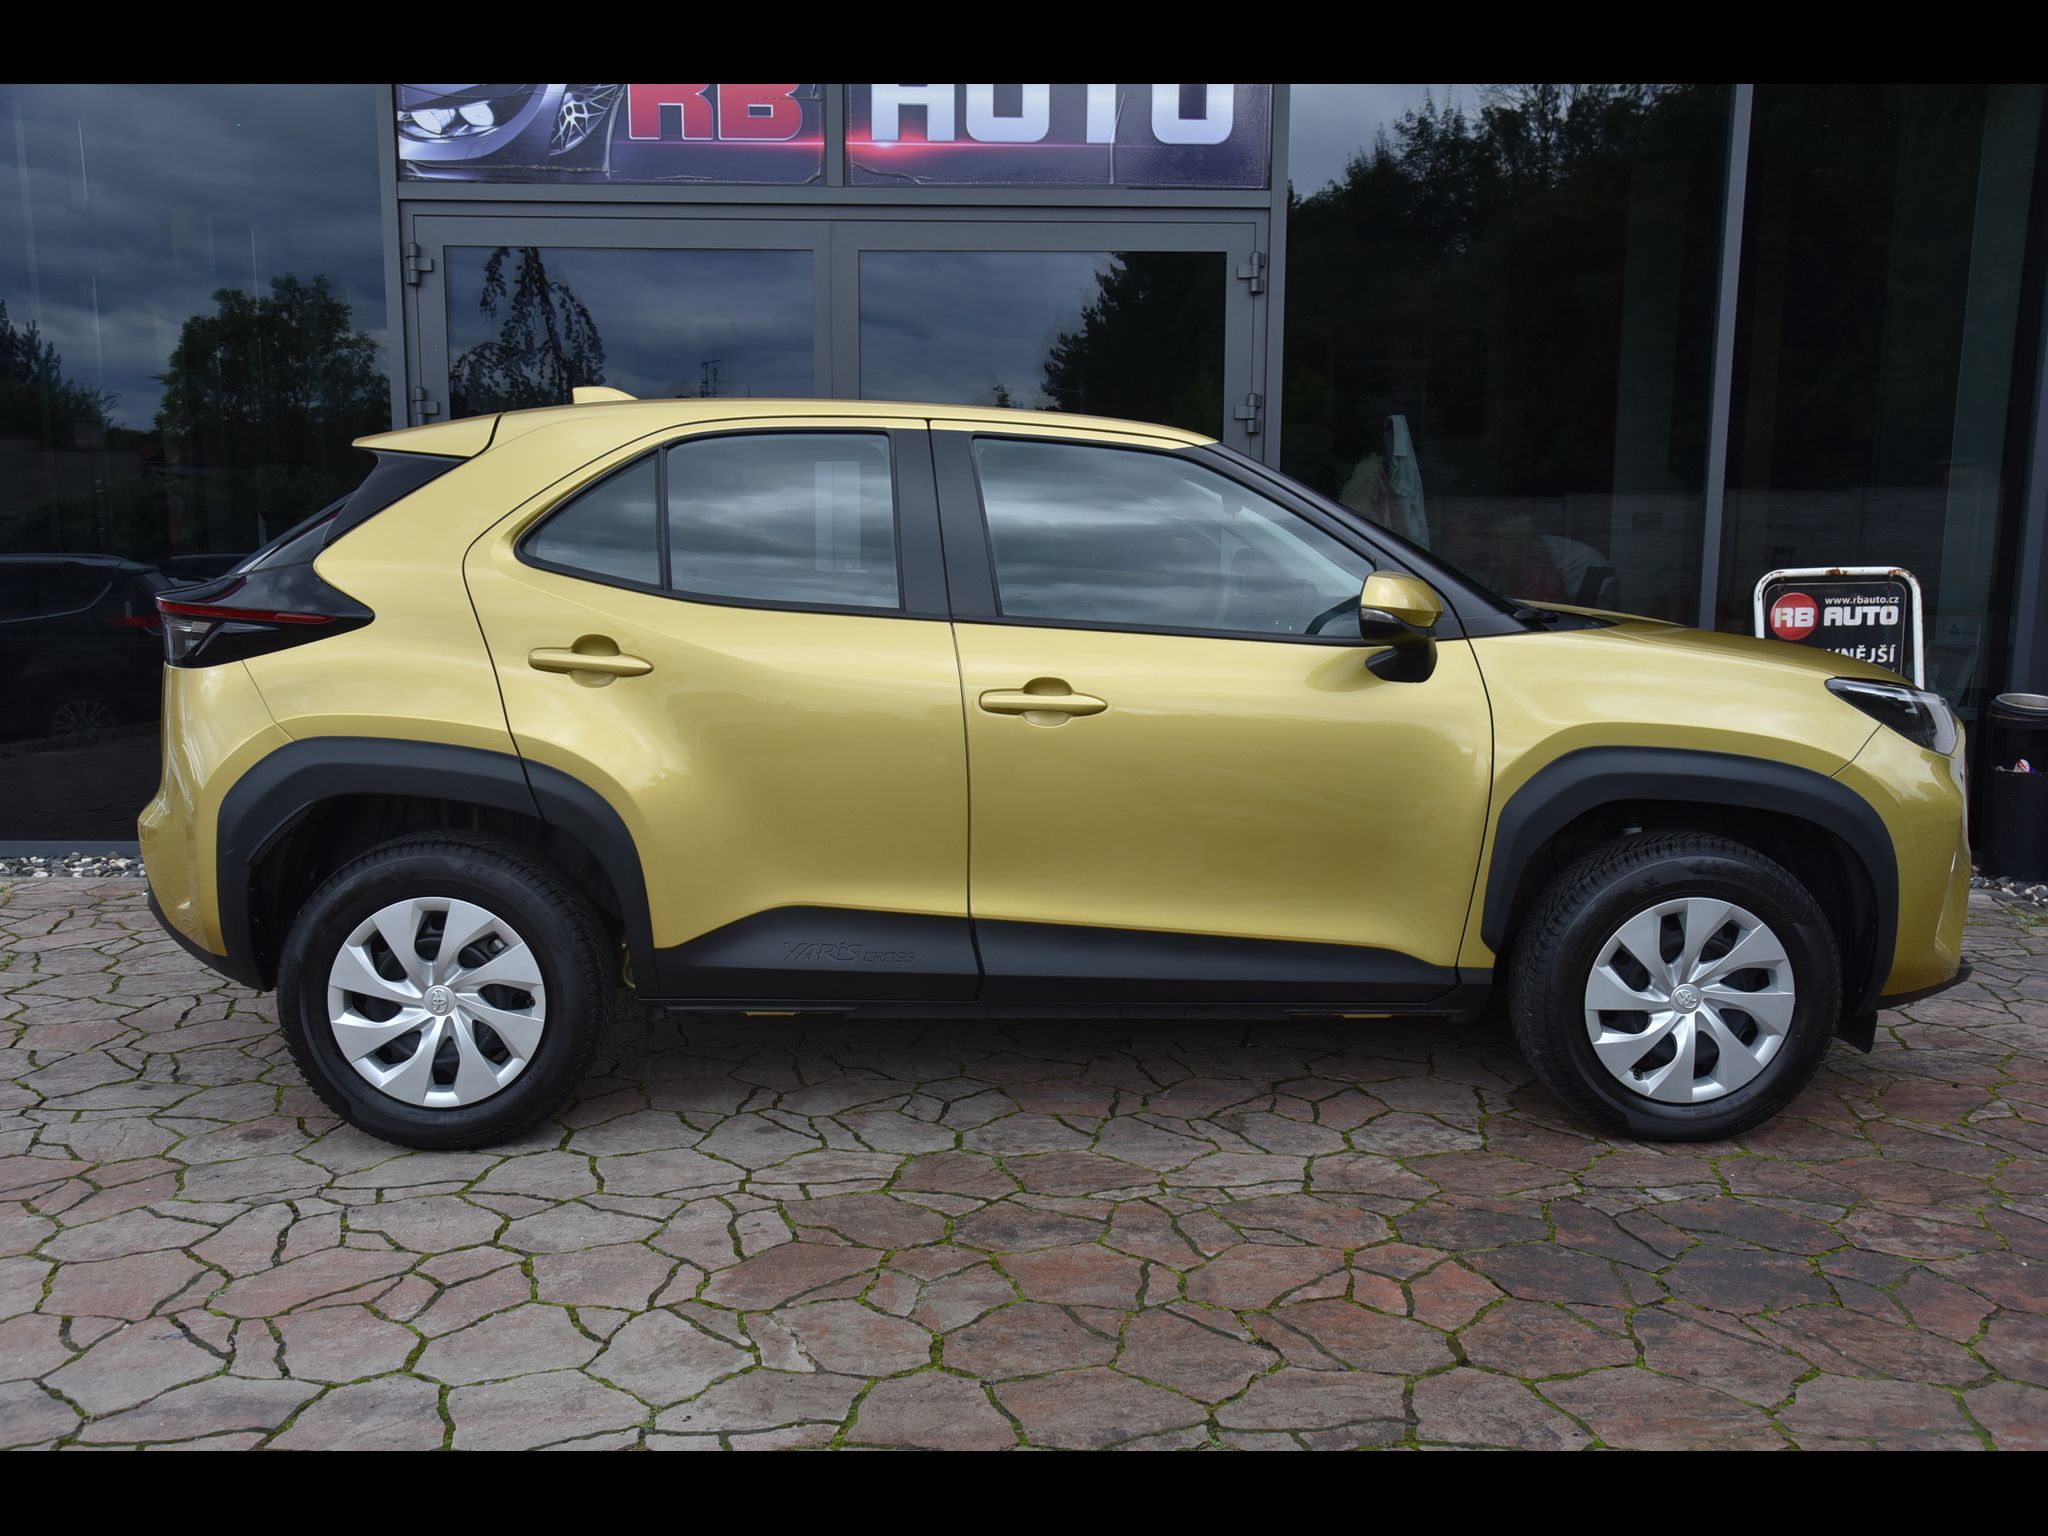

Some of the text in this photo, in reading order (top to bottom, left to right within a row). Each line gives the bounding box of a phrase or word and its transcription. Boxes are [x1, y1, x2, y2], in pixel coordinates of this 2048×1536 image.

[628, 84, 803, 141] RB
[1824, 595, 1899, 604] www.rbauto.cz
[1774, 605, 1899, 628] RB AUTO
[783, 941, 916, 963] YARIS CROSS
